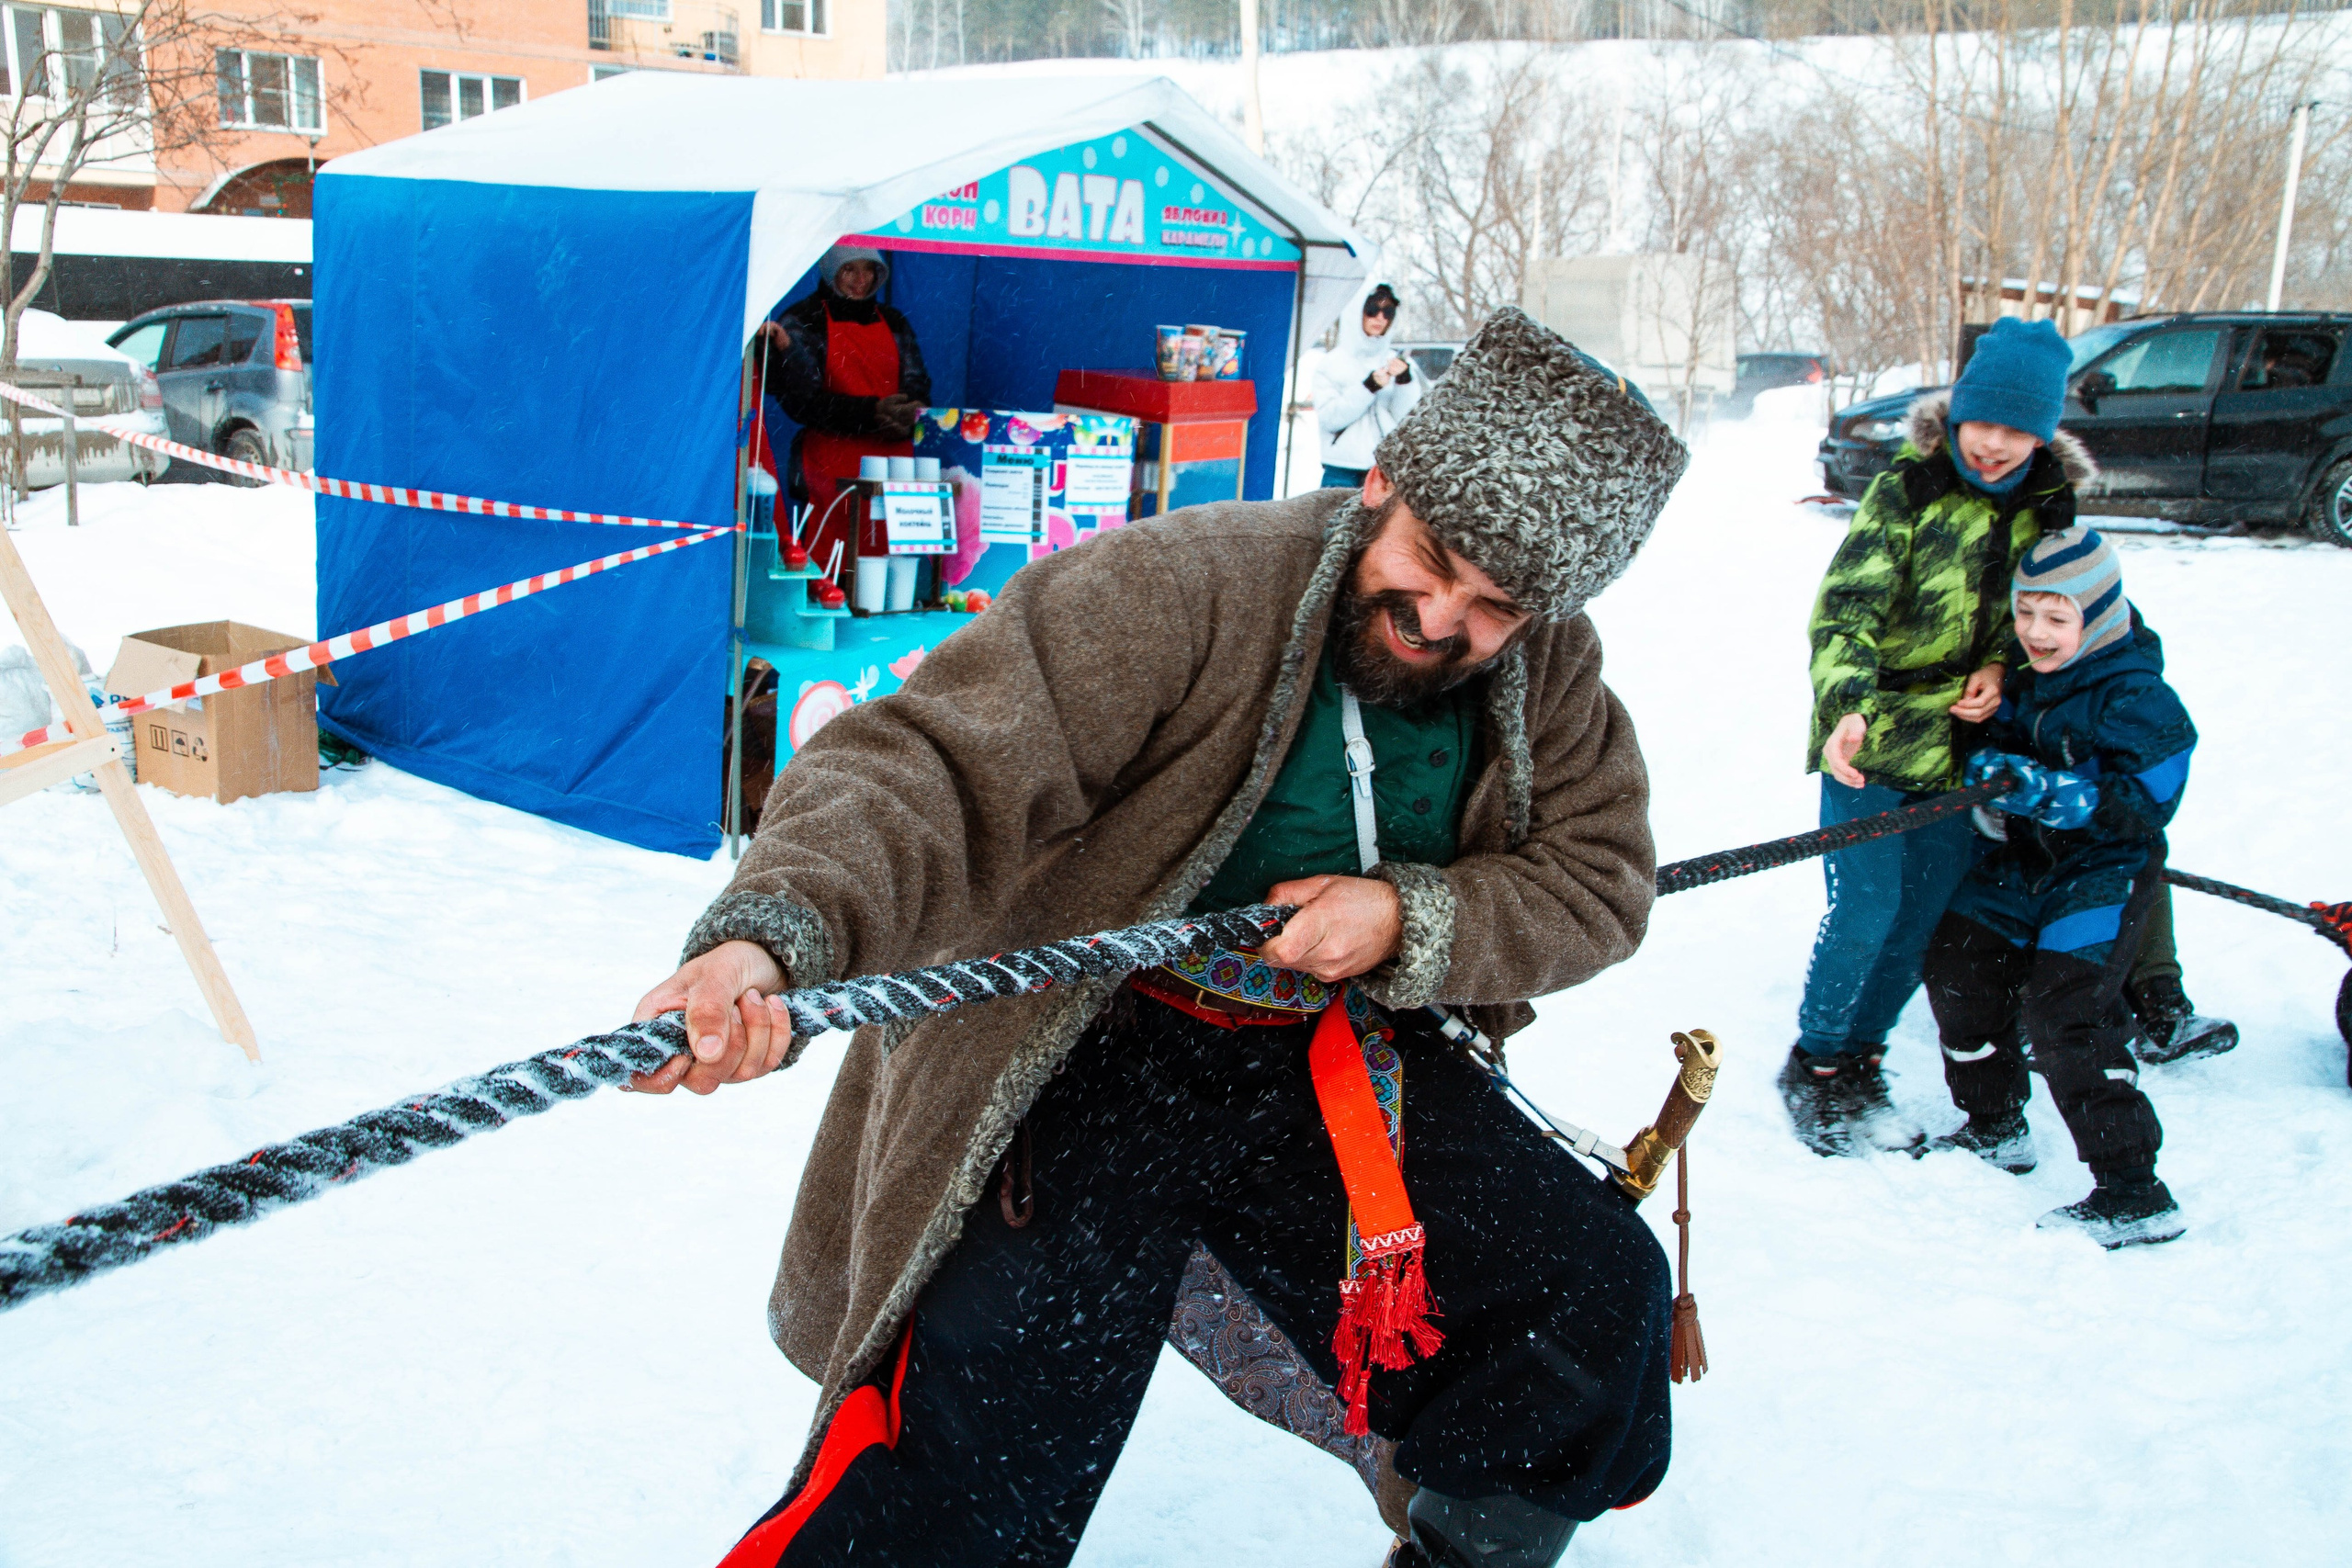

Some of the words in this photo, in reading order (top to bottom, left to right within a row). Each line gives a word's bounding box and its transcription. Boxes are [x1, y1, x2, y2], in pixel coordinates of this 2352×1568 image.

[923, 204, 978, 227] КОРН
[1008, 164, 1146, 244] ВАТА
[996, 454, 1035, 465] Меню
